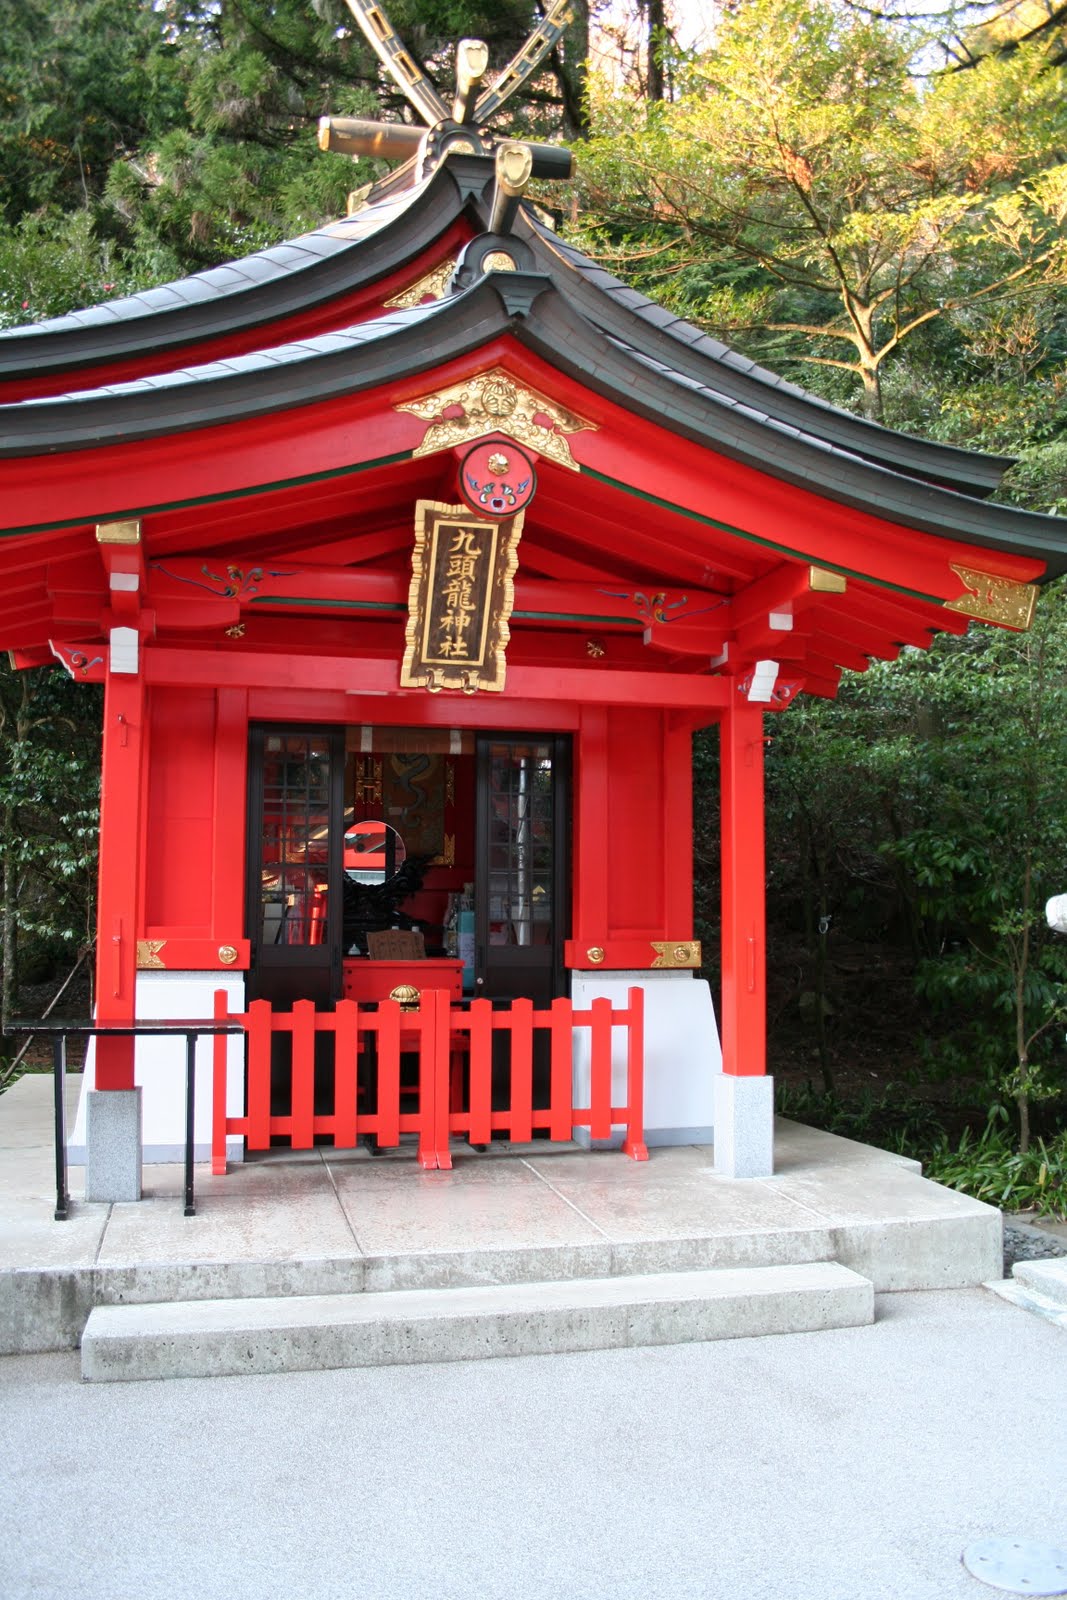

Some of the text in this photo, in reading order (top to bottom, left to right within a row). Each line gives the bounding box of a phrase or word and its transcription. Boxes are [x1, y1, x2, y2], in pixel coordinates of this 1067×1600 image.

[438, 528, 481, 657] 九頭龍神社
